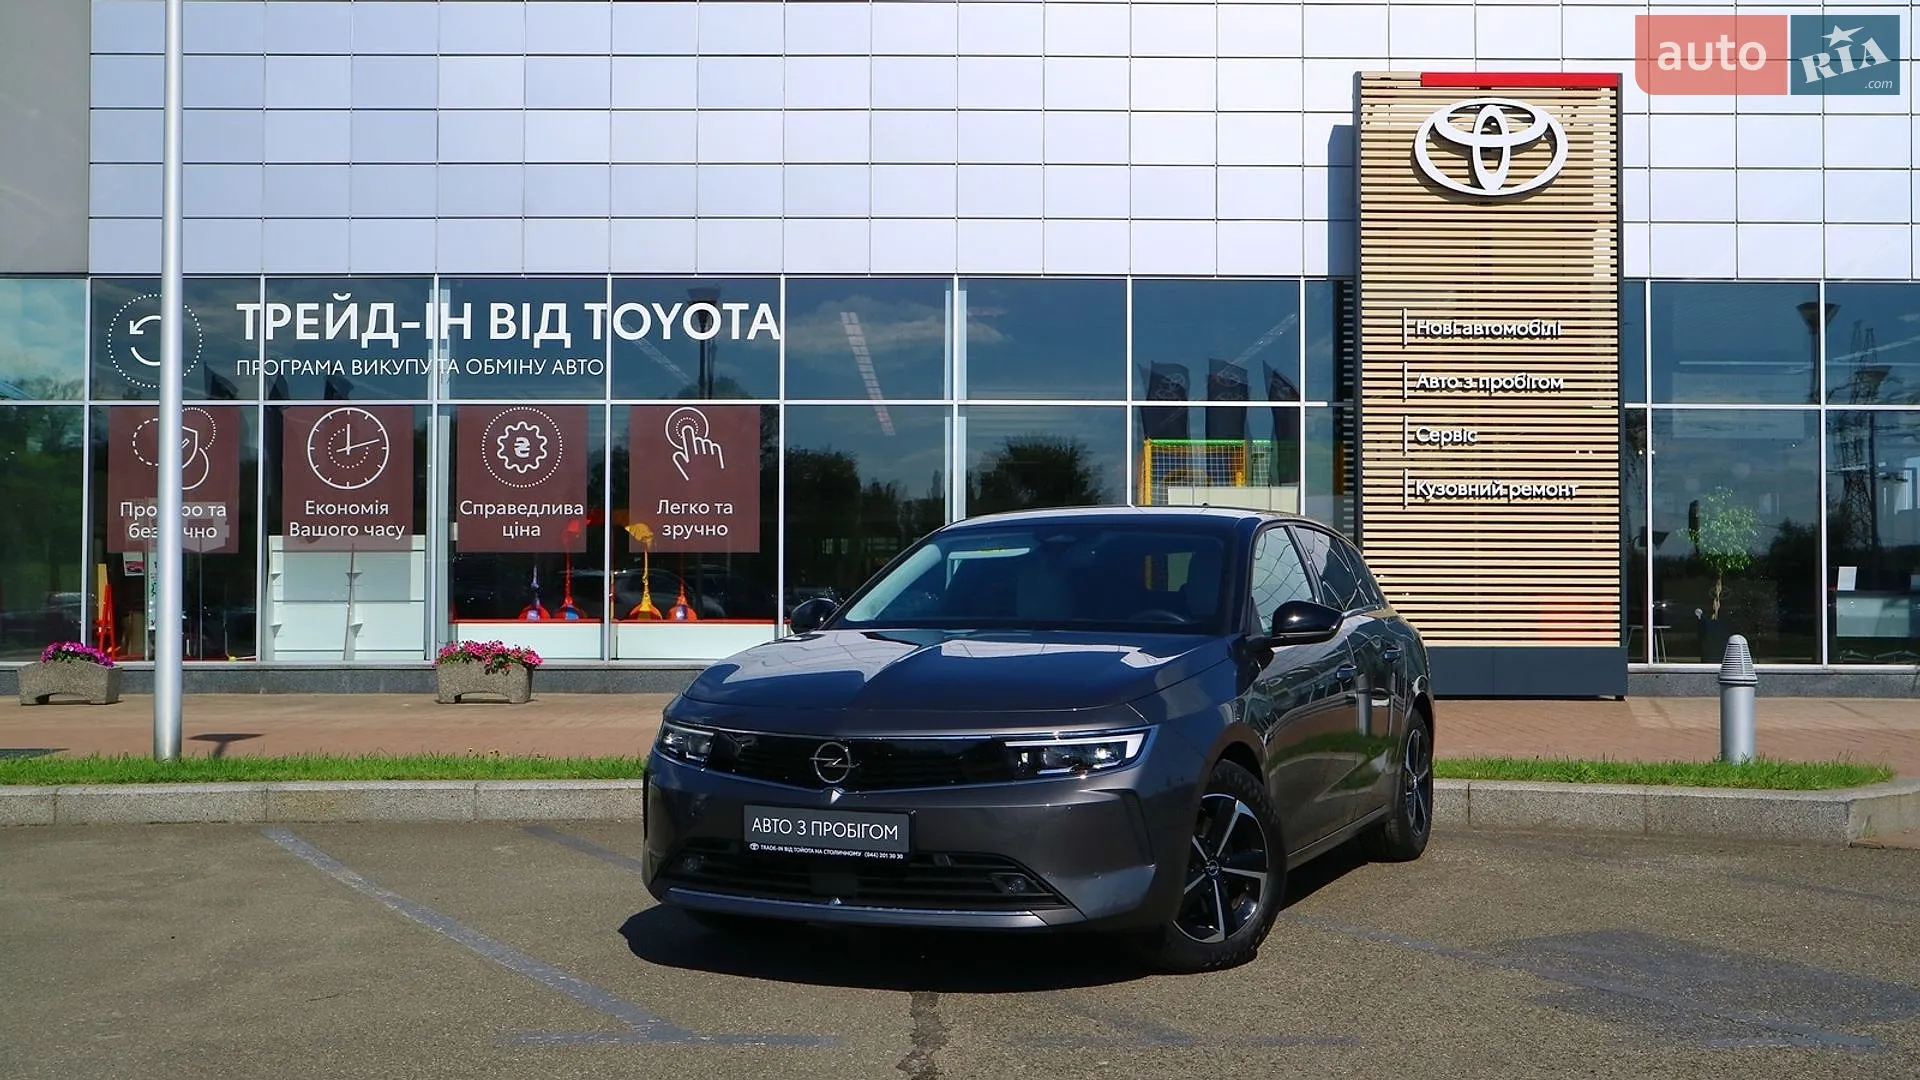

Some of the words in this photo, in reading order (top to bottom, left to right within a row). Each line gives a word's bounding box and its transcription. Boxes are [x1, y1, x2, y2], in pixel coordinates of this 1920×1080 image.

[490, 302, 572, 349] ВІД
[584, 302, 781, 341] TOYOTA
[1416, 320, 1457, 336] Нові
[1462, 319, 1562, 337] автомобілі
[237, 359, 345, 376] ПРОГРАМА
[352, 358, 433, 376] ВИКУПУ
[437, 358, 460, 375] ТА
[466, 358, 545, 376] ОБМІНУ
[551, 358, 604, 376] АВТО
[1416, 373, 1459, 389] Авто
[1463, 377, 1474, 389] з
[1479, 372, 1564, 392] пробігом
[1416, 426, 1478, 446] Сервіс
[1416, 480, 1504, 498] Кузовний
[1509, 484, 1579, 499] ремонт
[208, 505, 227, 517] та
[305, 500, 389, 515] Економія
[460, 500, 584, 518] Справедлива
[656, 500, 710, 514] Легко
[714, 503, 733, 514] та
[289, 522, 359, 537] Вашого
[364, 525, 406, 540] часу
[502, 521, 541, 539] ціна
[662, 524, 729, 540] зручно
[752, 817, 792, 834] АВТО
[811, 821, 898, 840] ПРОБІГОМ
